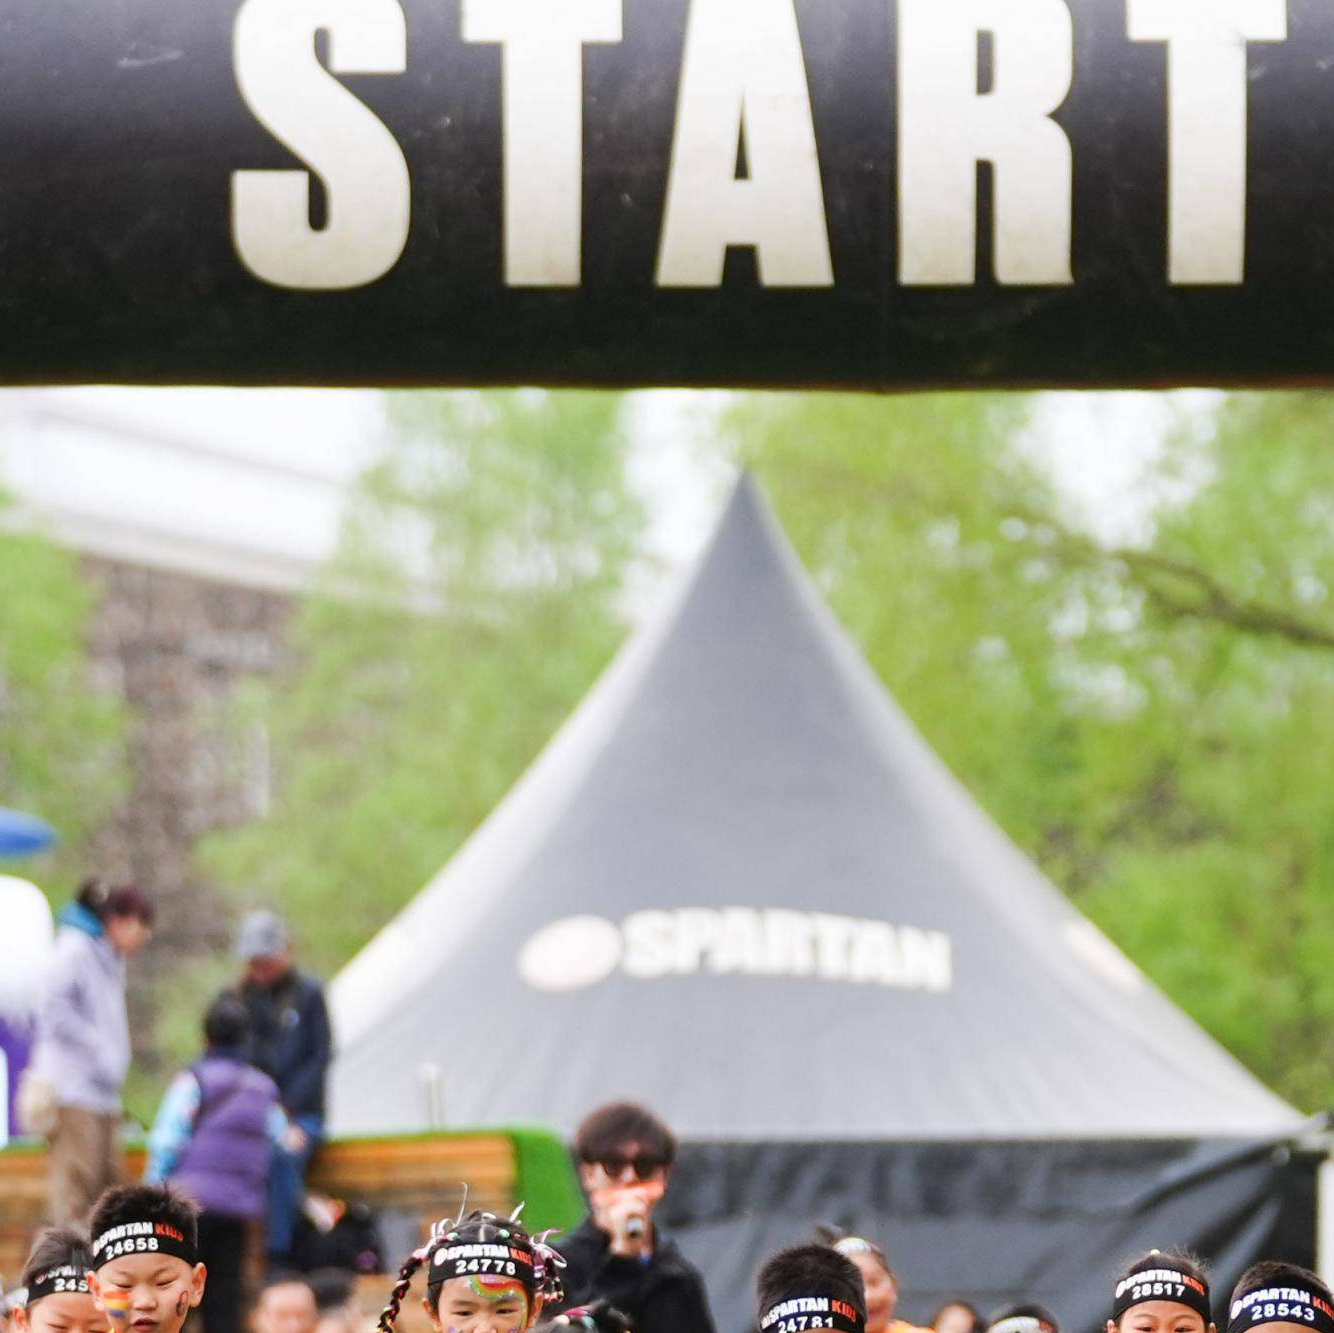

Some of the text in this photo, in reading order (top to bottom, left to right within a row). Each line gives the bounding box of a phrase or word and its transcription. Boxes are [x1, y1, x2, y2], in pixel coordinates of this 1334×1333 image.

[231, 0, 1287, 289] START
[621, 905, 953, 992] SPARTAN
[100, 1221, 153, 1249] SPARTAN
[105, 1237, 159, 1260] 24658
[446, 1244, 510, 1260] SPARTAN
[455, 1259, 516, 1276] 24778
[54, 1278, 89, 1293] 245
[1124, 1269, 1182, 1290] SPARTAN
[1132, 1283, 1186, 1300] 28517
[1241, 1287, 1311, 1309] SPARTAN
[768, 1297, 829, 1321] SPARTAN
[1250, 1303, 1315, 1321] 28543
